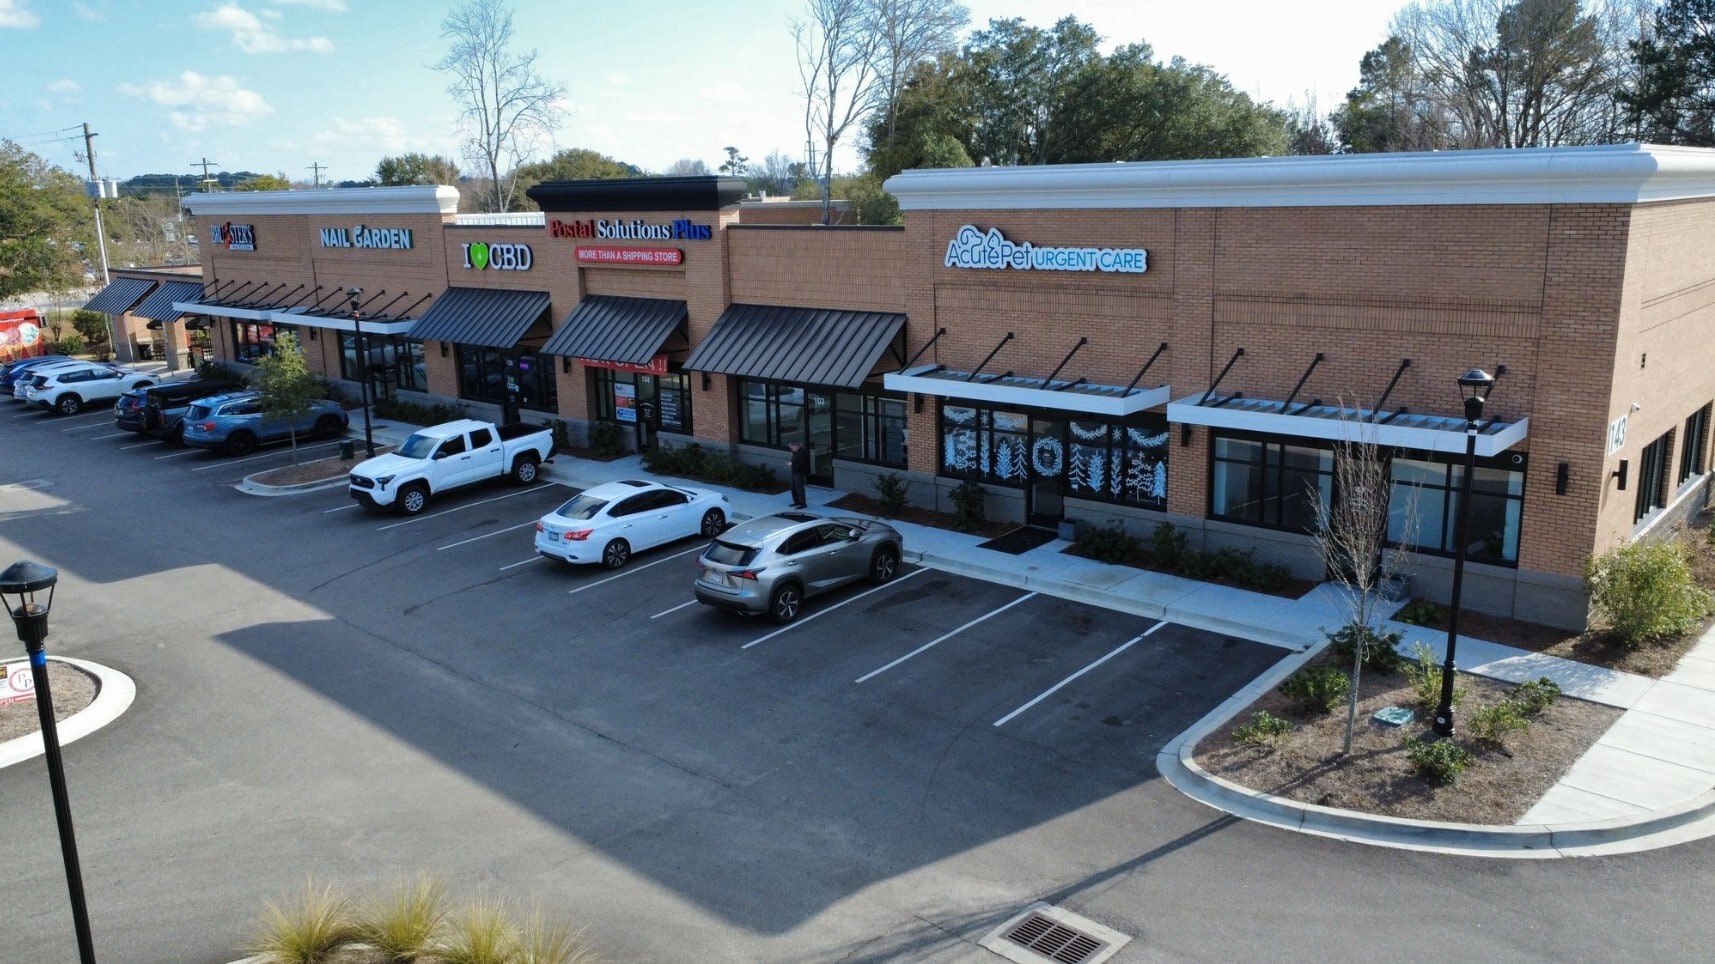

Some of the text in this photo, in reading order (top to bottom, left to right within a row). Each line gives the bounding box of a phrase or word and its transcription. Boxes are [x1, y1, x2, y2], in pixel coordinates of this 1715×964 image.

[320, 225, 412, 249] NAIL GARDEN
[551, 219, 712, 240] Postal Solutions Plus
[462, 243, 531, 270] I CBD
[578, 249, 678, 262] MORE THAN A SHIPPING STORE
[1035, 251, 1096, 267] URGENT
[1100, 252, 1144, 269] CARE
[1610, 417, 1626, 453] 143
